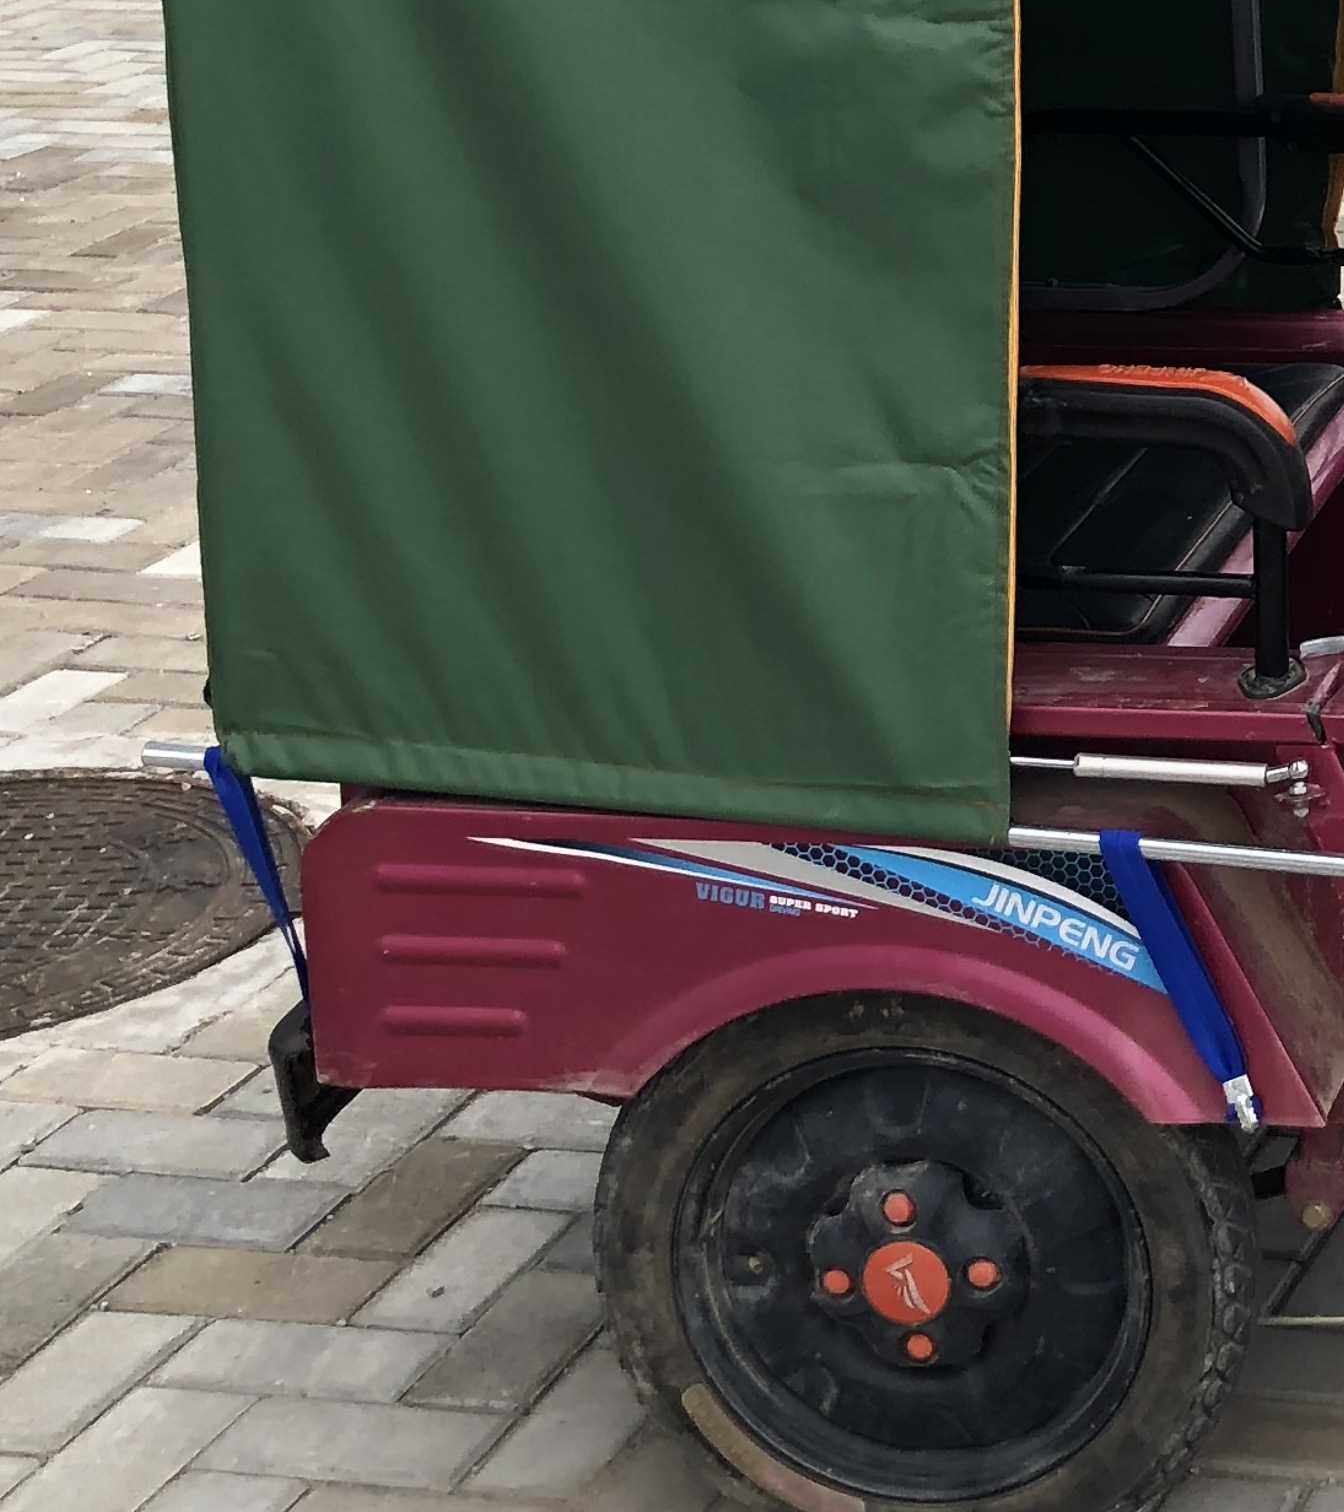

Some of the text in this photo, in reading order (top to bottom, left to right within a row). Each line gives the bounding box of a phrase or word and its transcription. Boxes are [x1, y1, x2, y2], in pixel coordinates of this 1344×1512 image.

[769, 895, 811, 910] SUPER
[815, 902, 859, 919] SPORT
[972, 884, 1140, 971] JINPENG
